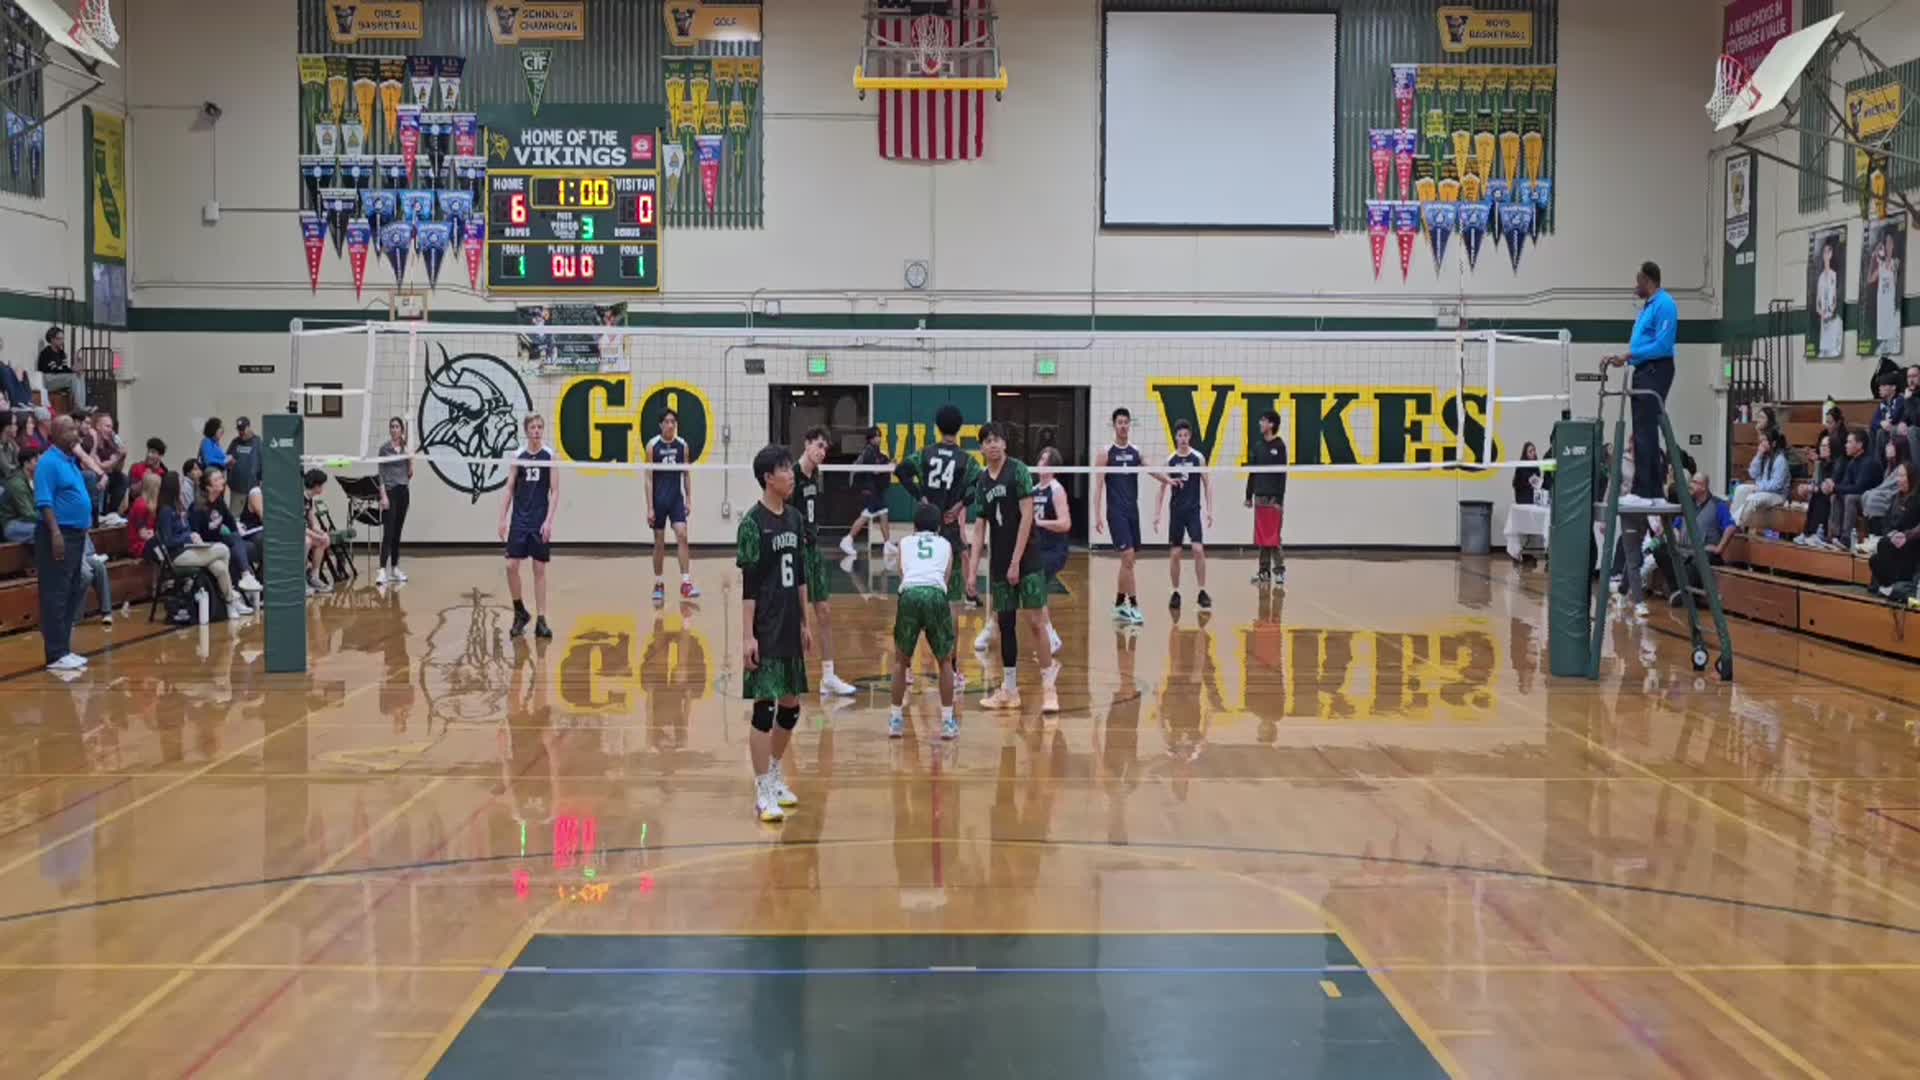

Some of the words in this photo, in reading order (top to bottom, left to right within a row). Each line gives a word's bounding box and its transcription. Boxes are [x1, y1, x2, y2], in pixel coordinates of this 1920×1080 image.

[522, 8, 559, 19] SCHOOL
[713, 17, 737, 27] GOLF
[358, 21, 418, 31] BASKETBALL
[520, 21, 578, 32] CHAMPIONS
[523, 56, 547, 70] CIF
[521, 129, 563, 145] HOME
[566, 129, 587, 145] OF
[589, 129, 618, 145] THE
[513, 146, 627, 166] VIKINGS
[493, 178, 524, 190] HOME
[558, 179, 609, 206] 1:00
[615, 178, 656, 190] VISITOR
[511, 193, 526, 224] 6
[638, 194, 653, 224] 0
[582, 215, 594, 239] 3
[558, 376, 710, 468] GO
[1150, 382, 1500, 472] VIKES
[525, 467, 540, 482] 13
[927, 456, 956, 490] 24
[917, 536, 933, 560] 5
[781, 552, 794, 588] 6
